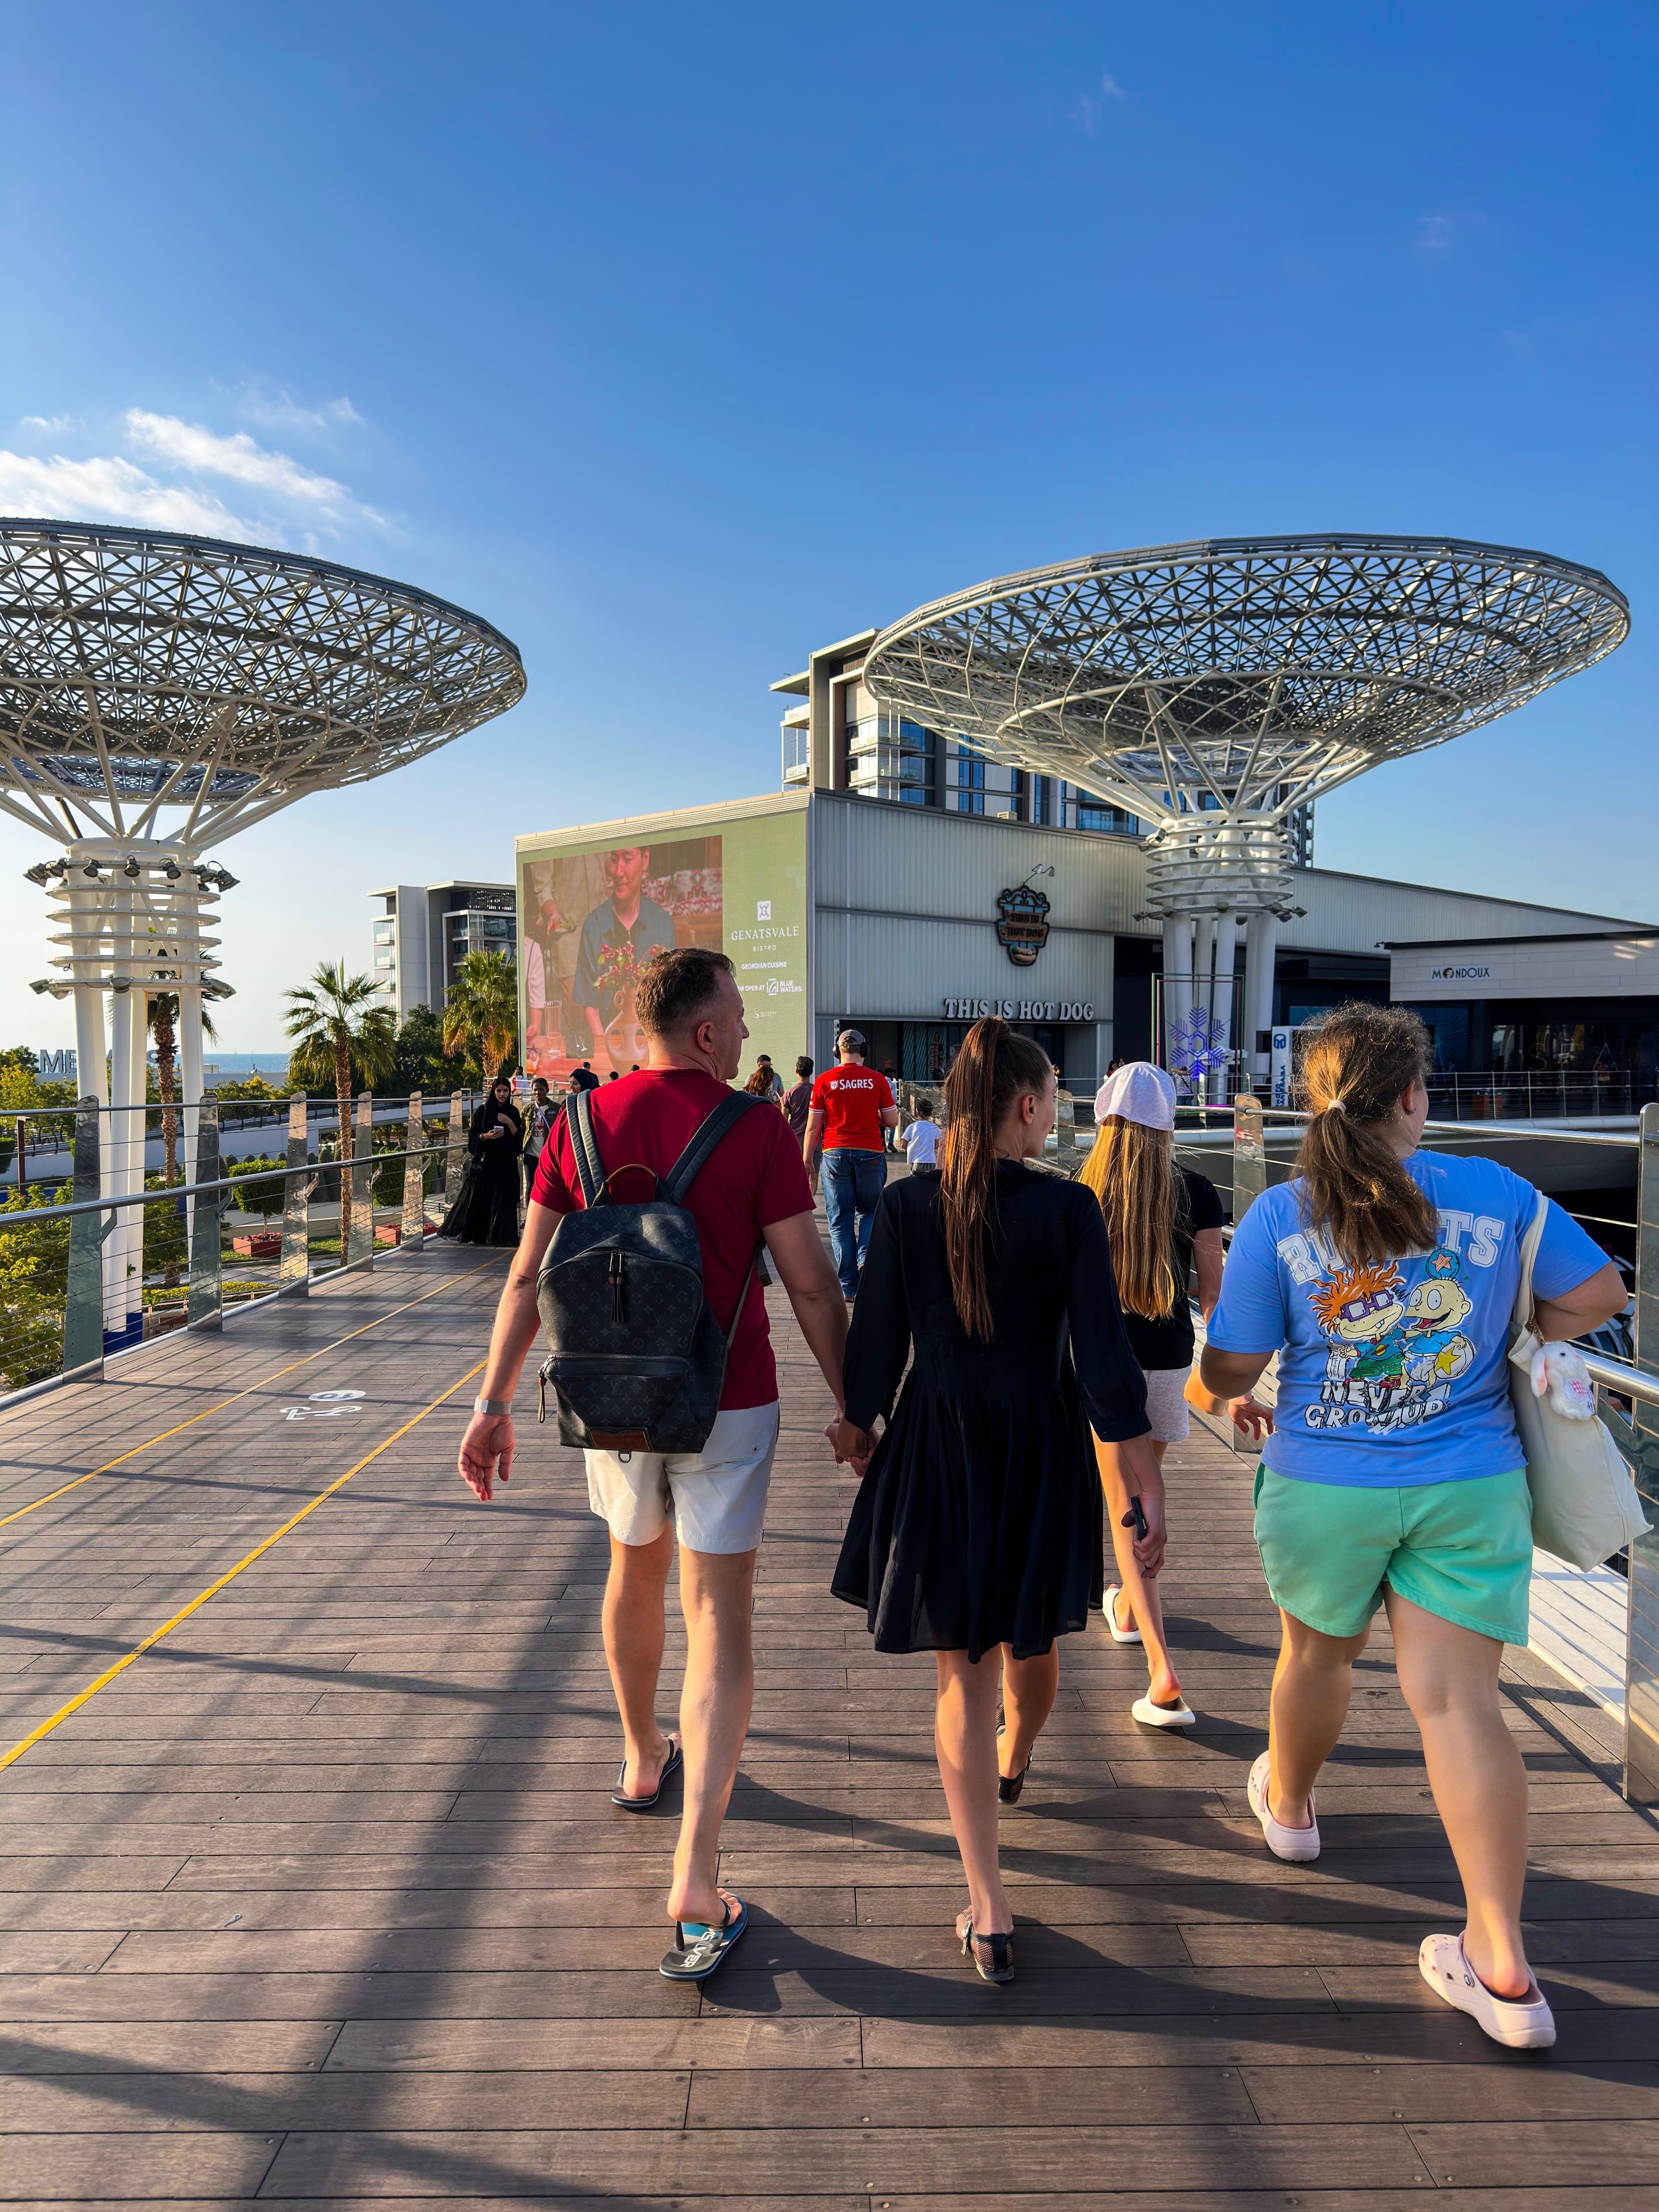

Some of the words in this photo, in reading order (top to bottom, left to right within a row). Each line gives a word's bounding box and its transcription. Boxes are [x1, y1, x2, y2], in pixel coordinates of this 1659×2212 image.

[1011, 913, 1030, 922] THIS
[1031, 914, 1040, 923] IS
[731, 926, 800, 941] GENATSVALE
[1008, 927, 1025, 937] HOT
[1027, 928, 1044, 938] DOG
[945, 998, 990, 1019] THIS
[996, 1000, 1013, 1019] IS
[1019, 1001, 1055, 1020] HOT
[1059, 1002, 1094, 1021] DOG
[839, 1078, 874, 1090] SAGRES
[1277, 1209, 1505, 1285] RUTS
[1319, 1380, 1429, 1412] NEVER
[1397, 1400, 1446, 1426] UP
